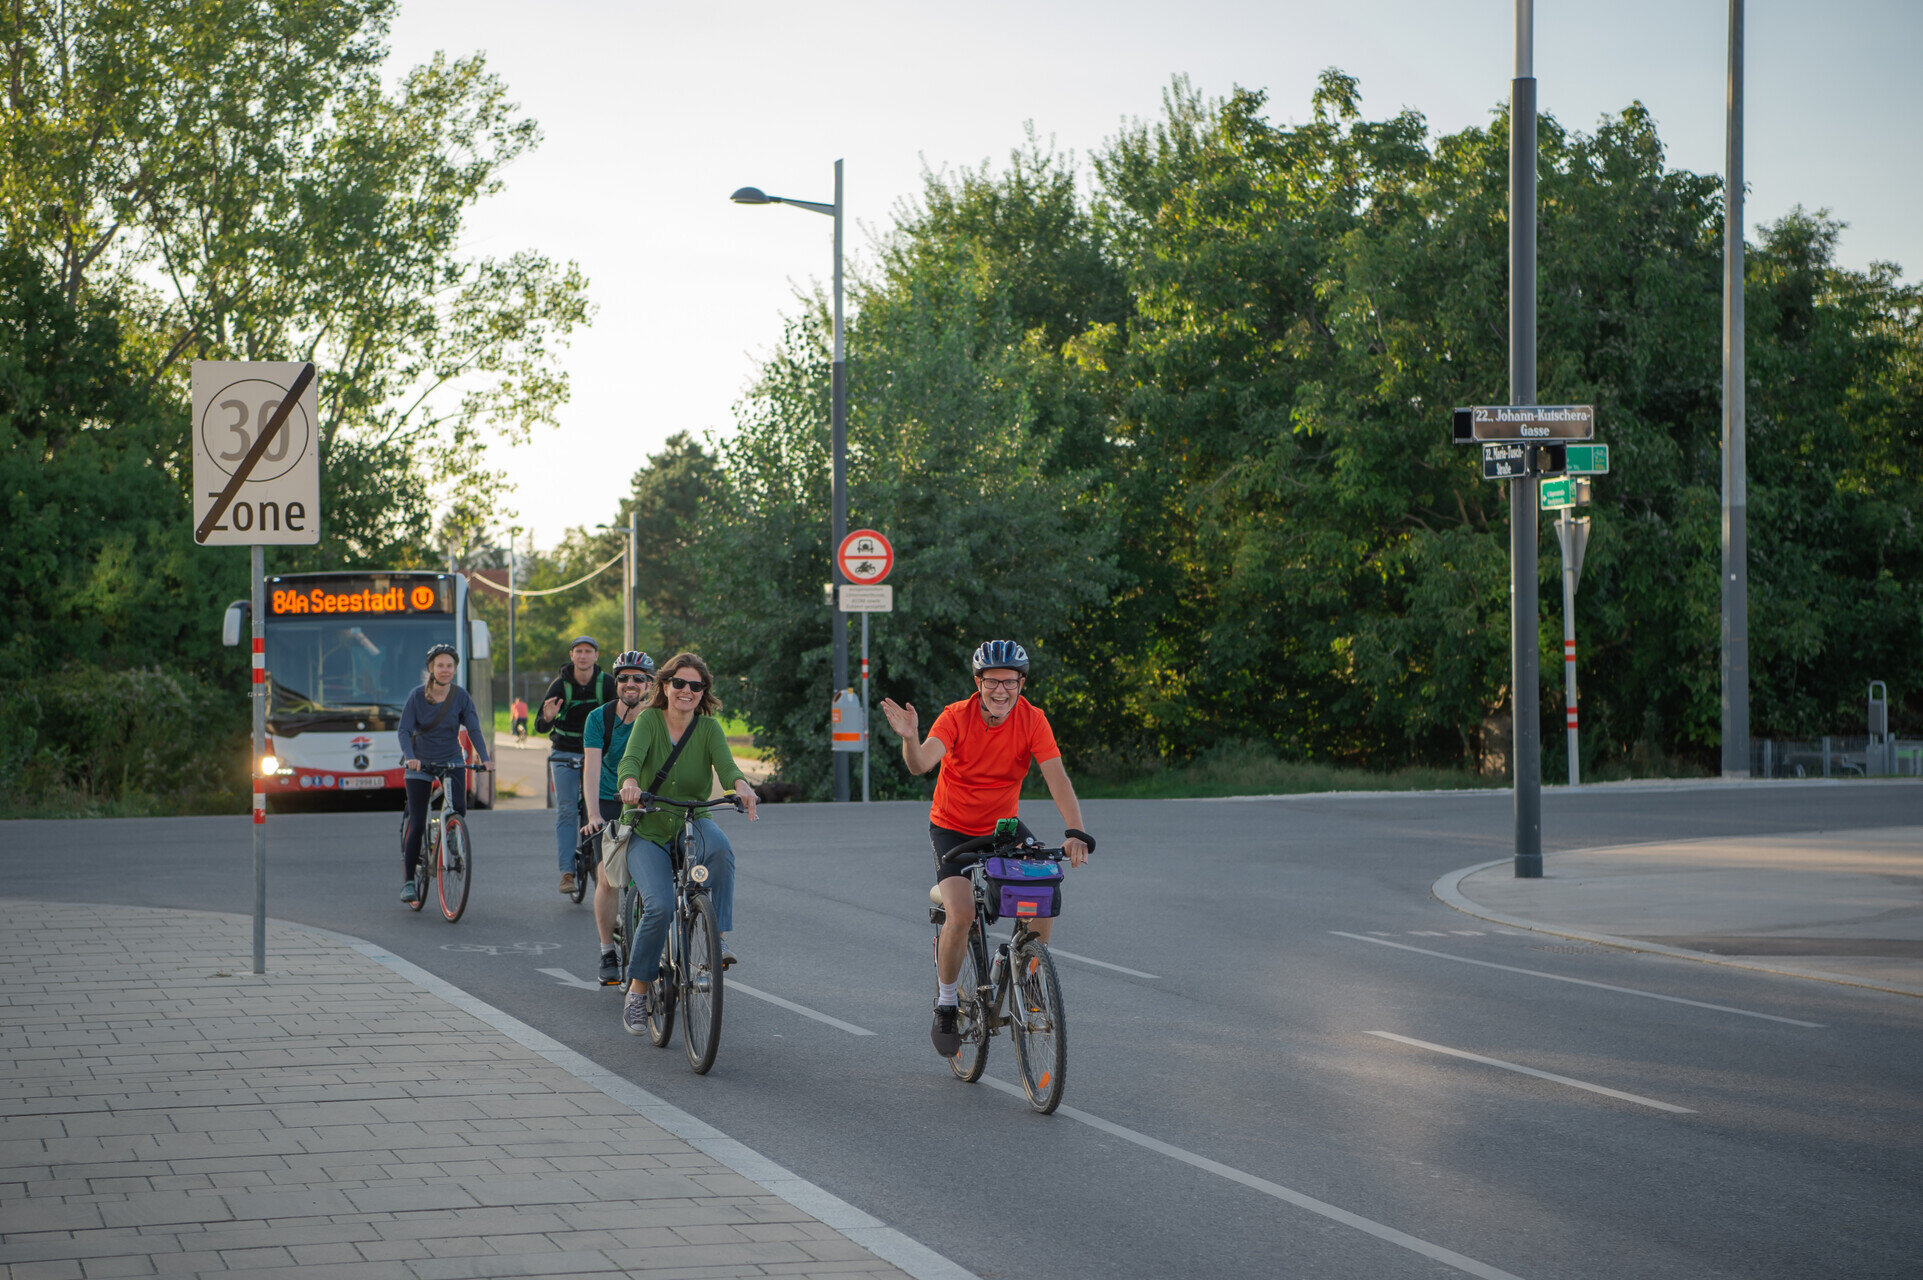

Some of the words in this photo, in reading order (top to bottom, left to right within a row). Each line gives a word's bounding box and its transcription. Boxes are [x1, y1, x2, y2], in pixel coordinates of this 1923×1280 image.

[1495, 408, 1591, 422] Johann-Kutschera-
[219, 398, 291, 462] 30
[1520, 423, 1550, 437] Gasse
[208, 492, 306, 532] Zone
[272, 589, 309, 614] 84A
[310, 587, 406, 613] Seestadt
